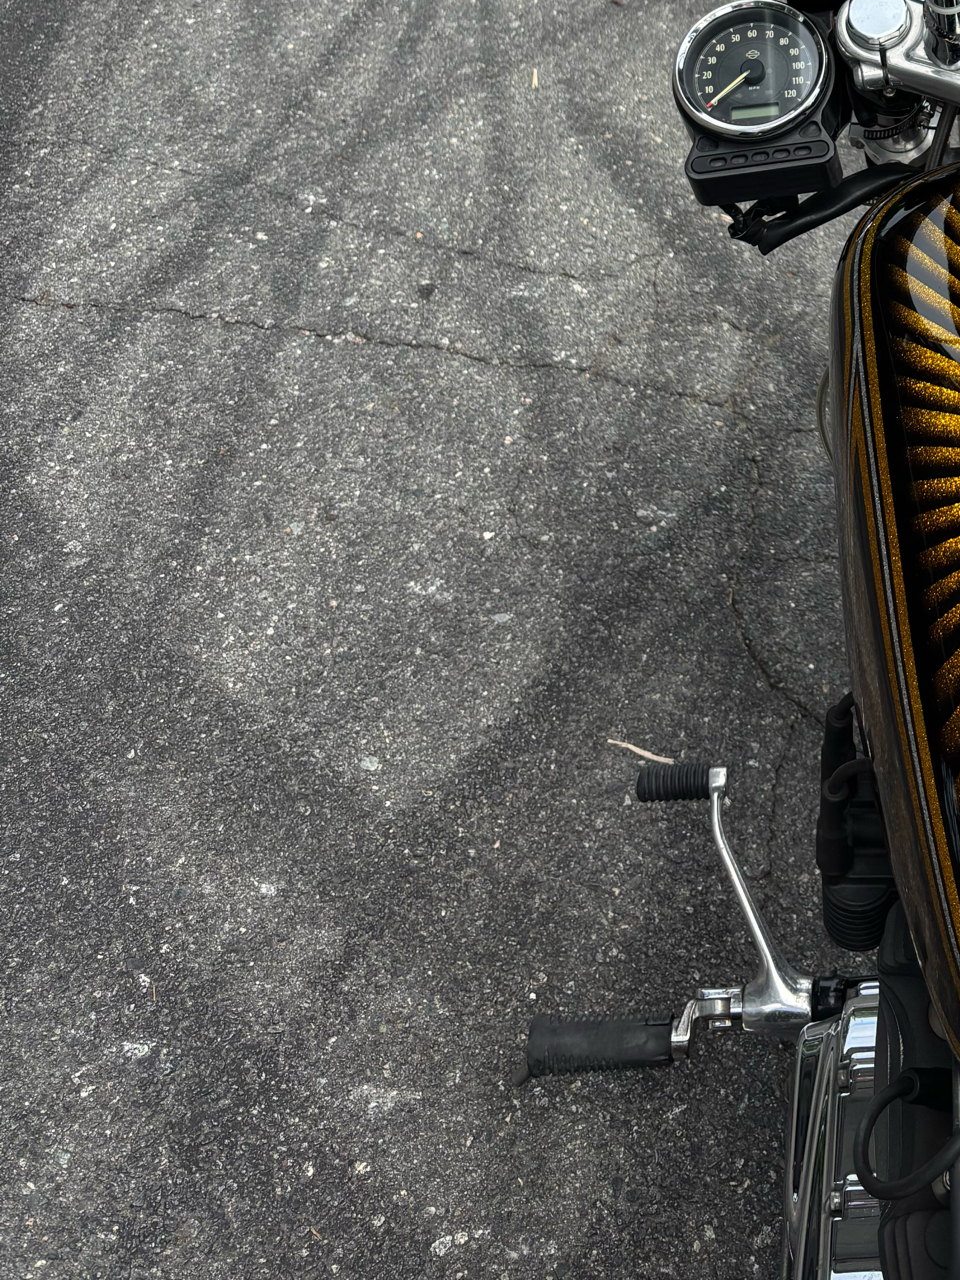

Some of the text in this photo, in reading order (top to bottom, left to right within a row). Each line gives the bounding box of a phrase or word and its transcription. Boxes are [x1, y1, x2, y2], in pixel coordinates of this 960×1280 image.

[731, 34, 741, 42] 50
[747, 29, 757, 38] 60
[765, 30, 774, 39] 70
[779, 37, 789, 46] 80
[715, 43, 725, 52] 40
[789, 47, 799, 56] 90
[707, 56, 717, 65] 30
[792, 61, 805, 70] 100
[702, 71, 712, 79] 20
[792, 76, 804, 85] 110
[705, 85, 714, 94] 10
[784, 89, 797, 98] 120
